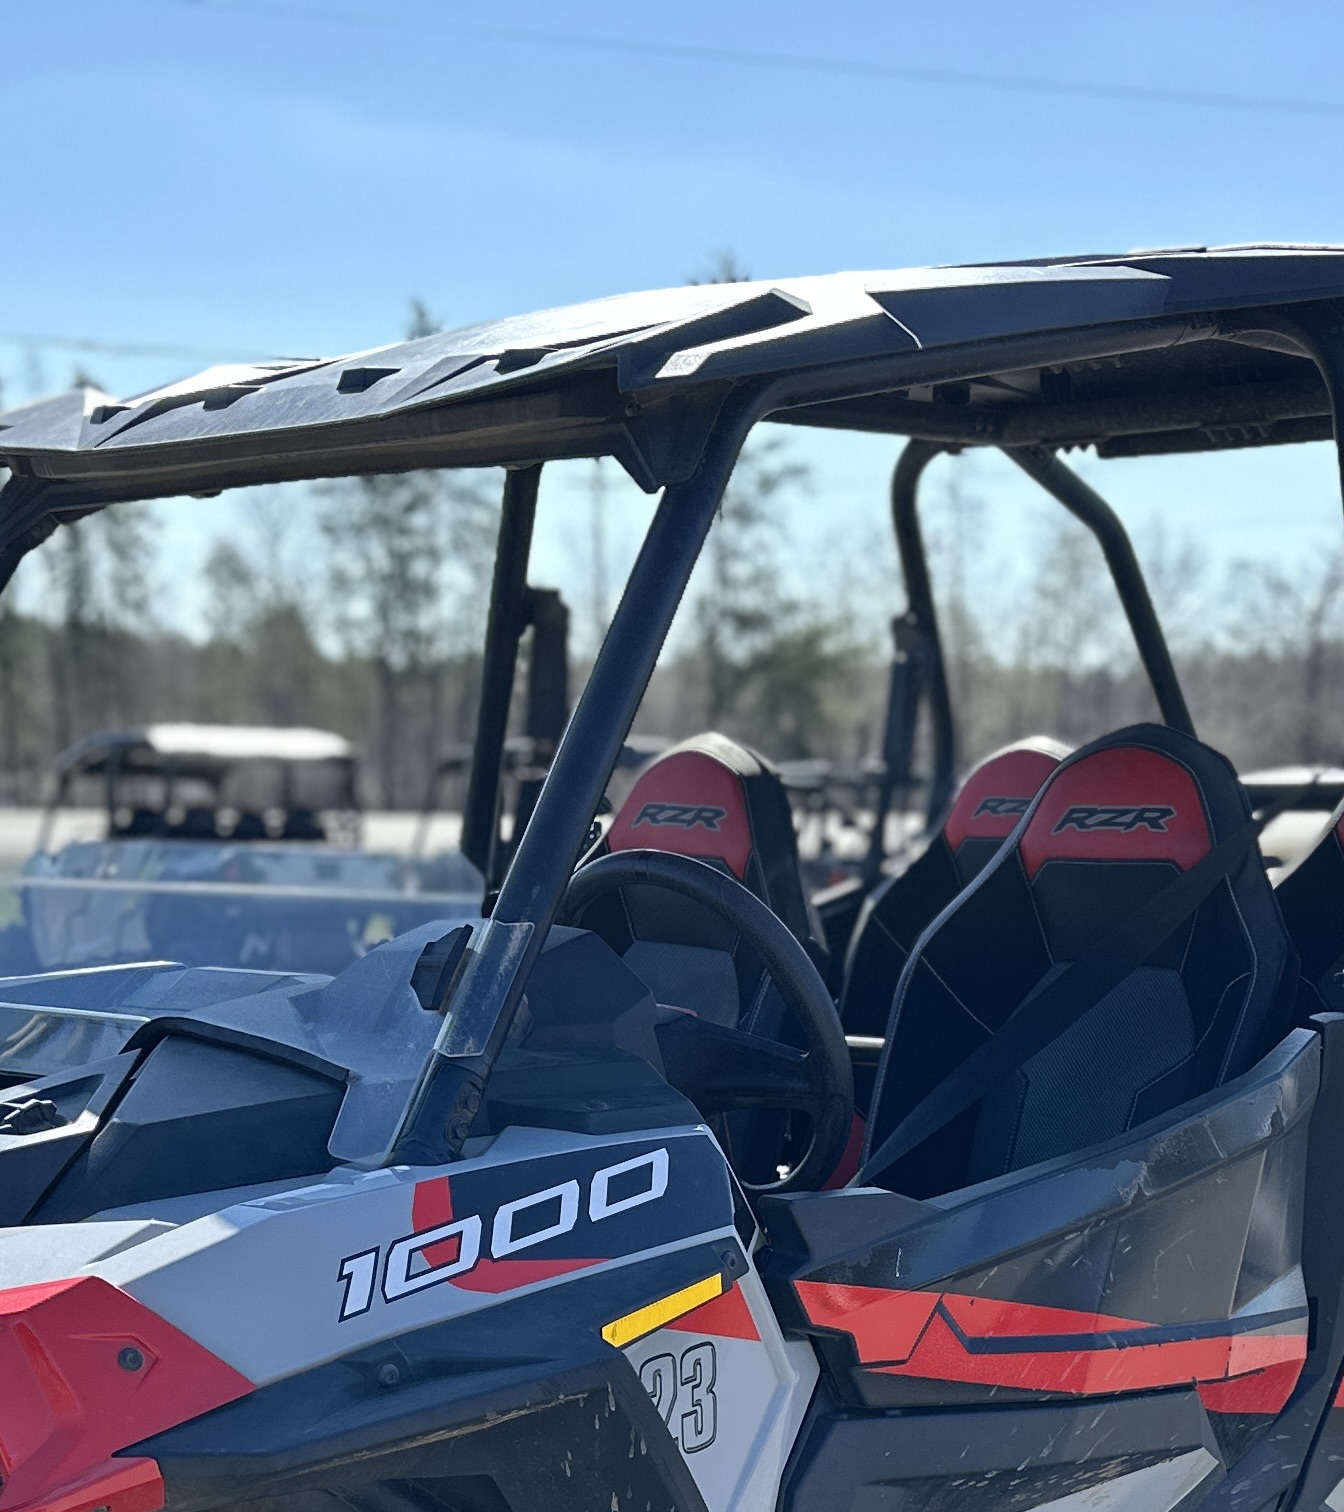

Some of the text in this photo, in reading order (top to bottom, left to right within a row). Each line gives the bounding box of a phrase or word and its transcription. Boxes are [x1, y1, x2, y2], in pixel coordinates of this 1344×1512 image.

[631, 803, 727, 832] RZR
[971, 796, 1038, 819] RZ
[1050, 805, 1177, 834] RZR
[337, 1147, 669, 1322] 1000
